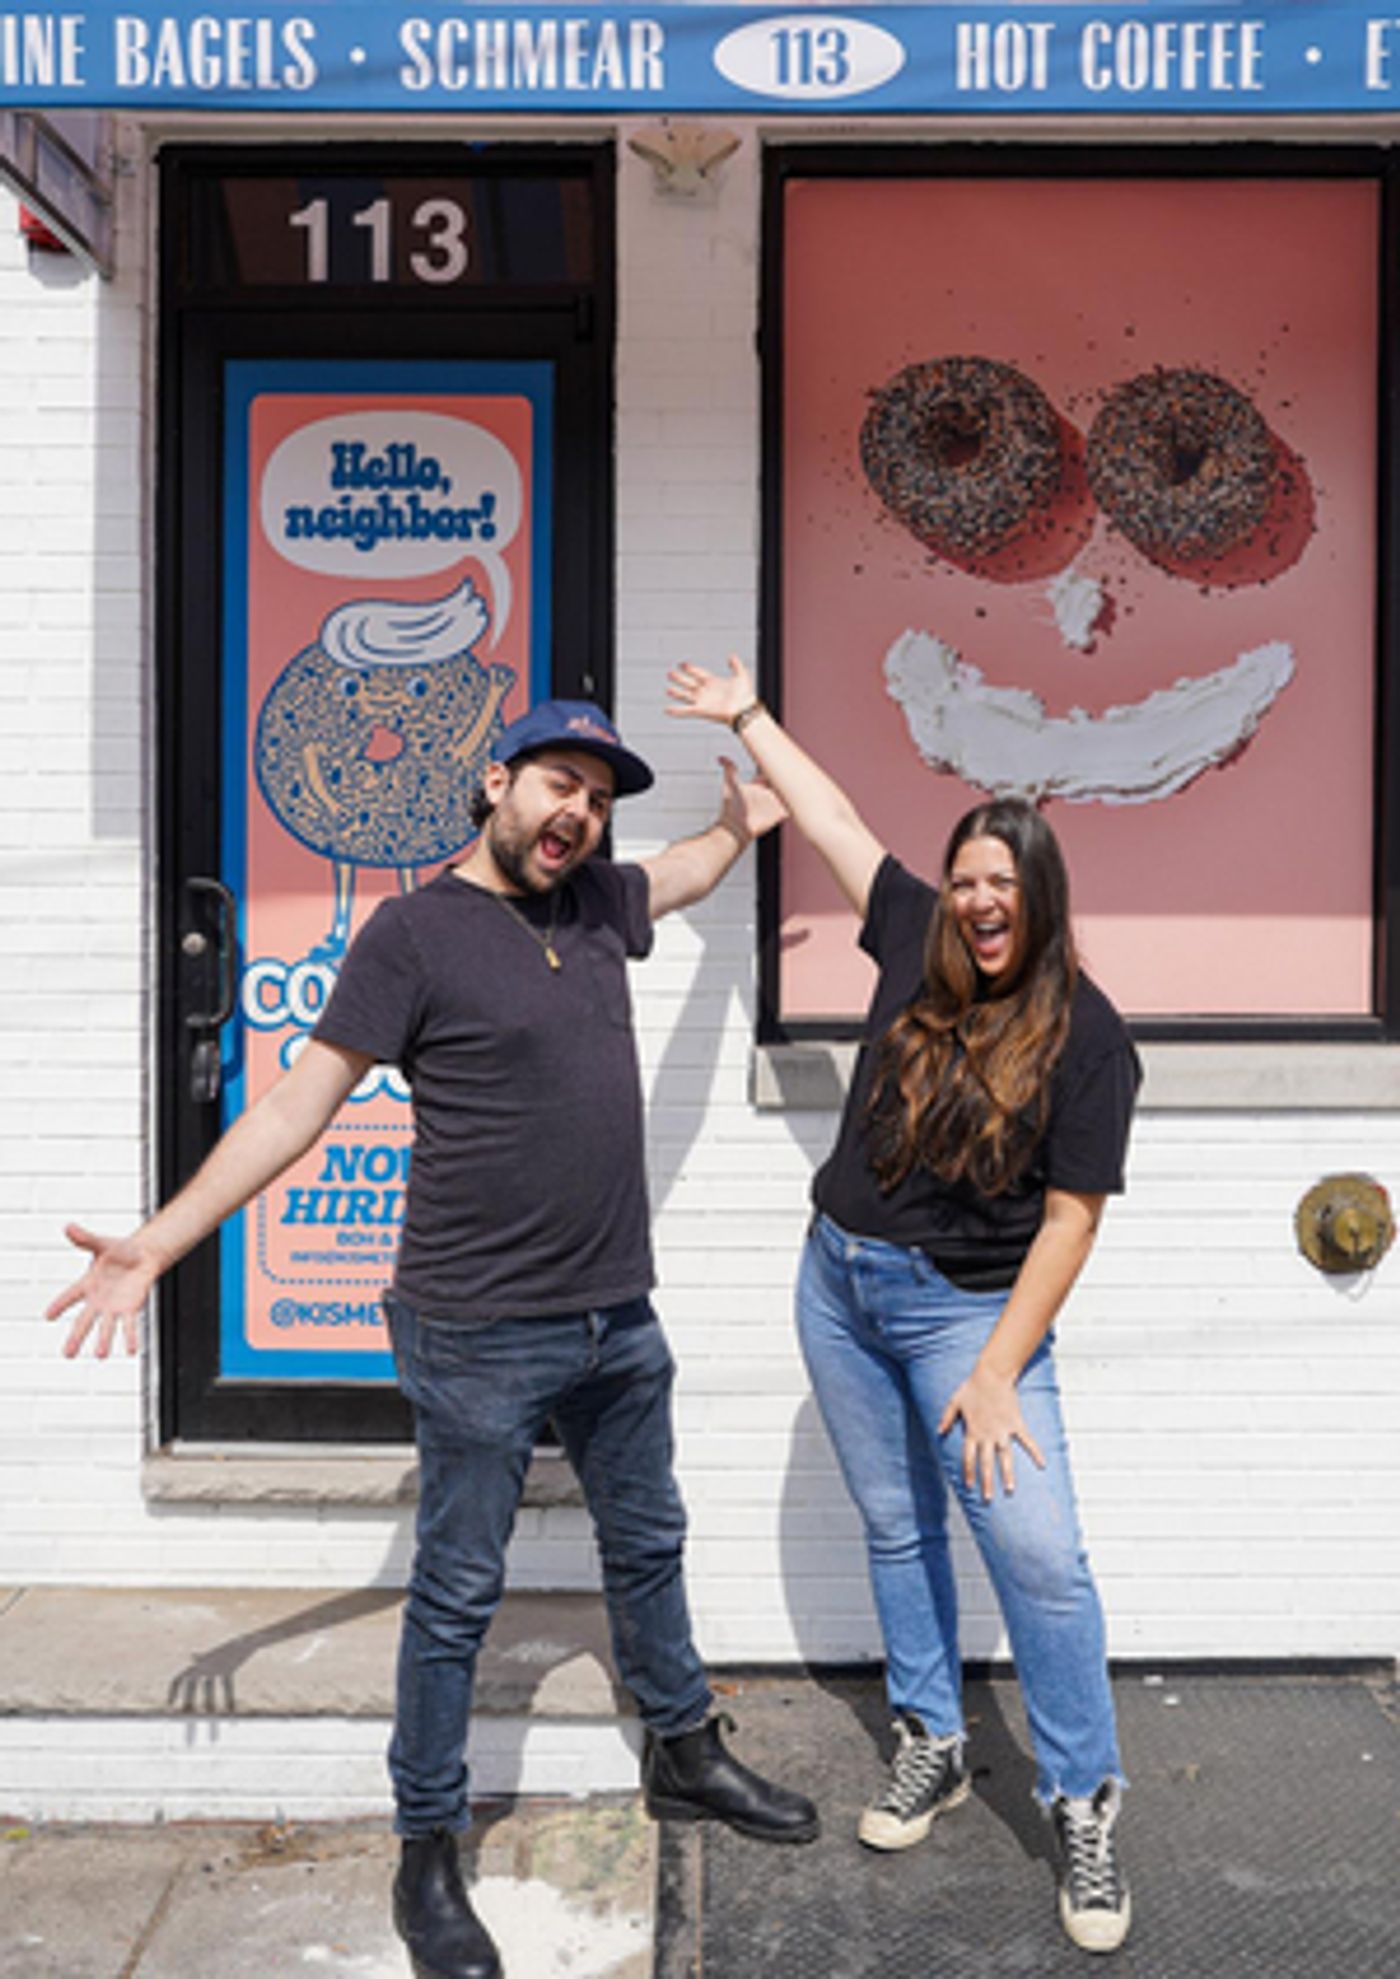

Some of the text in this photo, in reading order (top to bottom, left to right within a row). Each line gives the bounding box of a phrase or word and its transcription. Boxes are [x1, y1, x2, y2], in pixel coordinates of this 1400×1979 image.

[4, 15, 1400, 91] INE BAGELS SCHMEAR 113 HOT COFFEE E
[289, 199, 469, 283] 113
[331, 442, 452, 494] Hello,
[284, 492, 496, 551] neighbor!
[280, 1187, 408, 1225] HIRI
